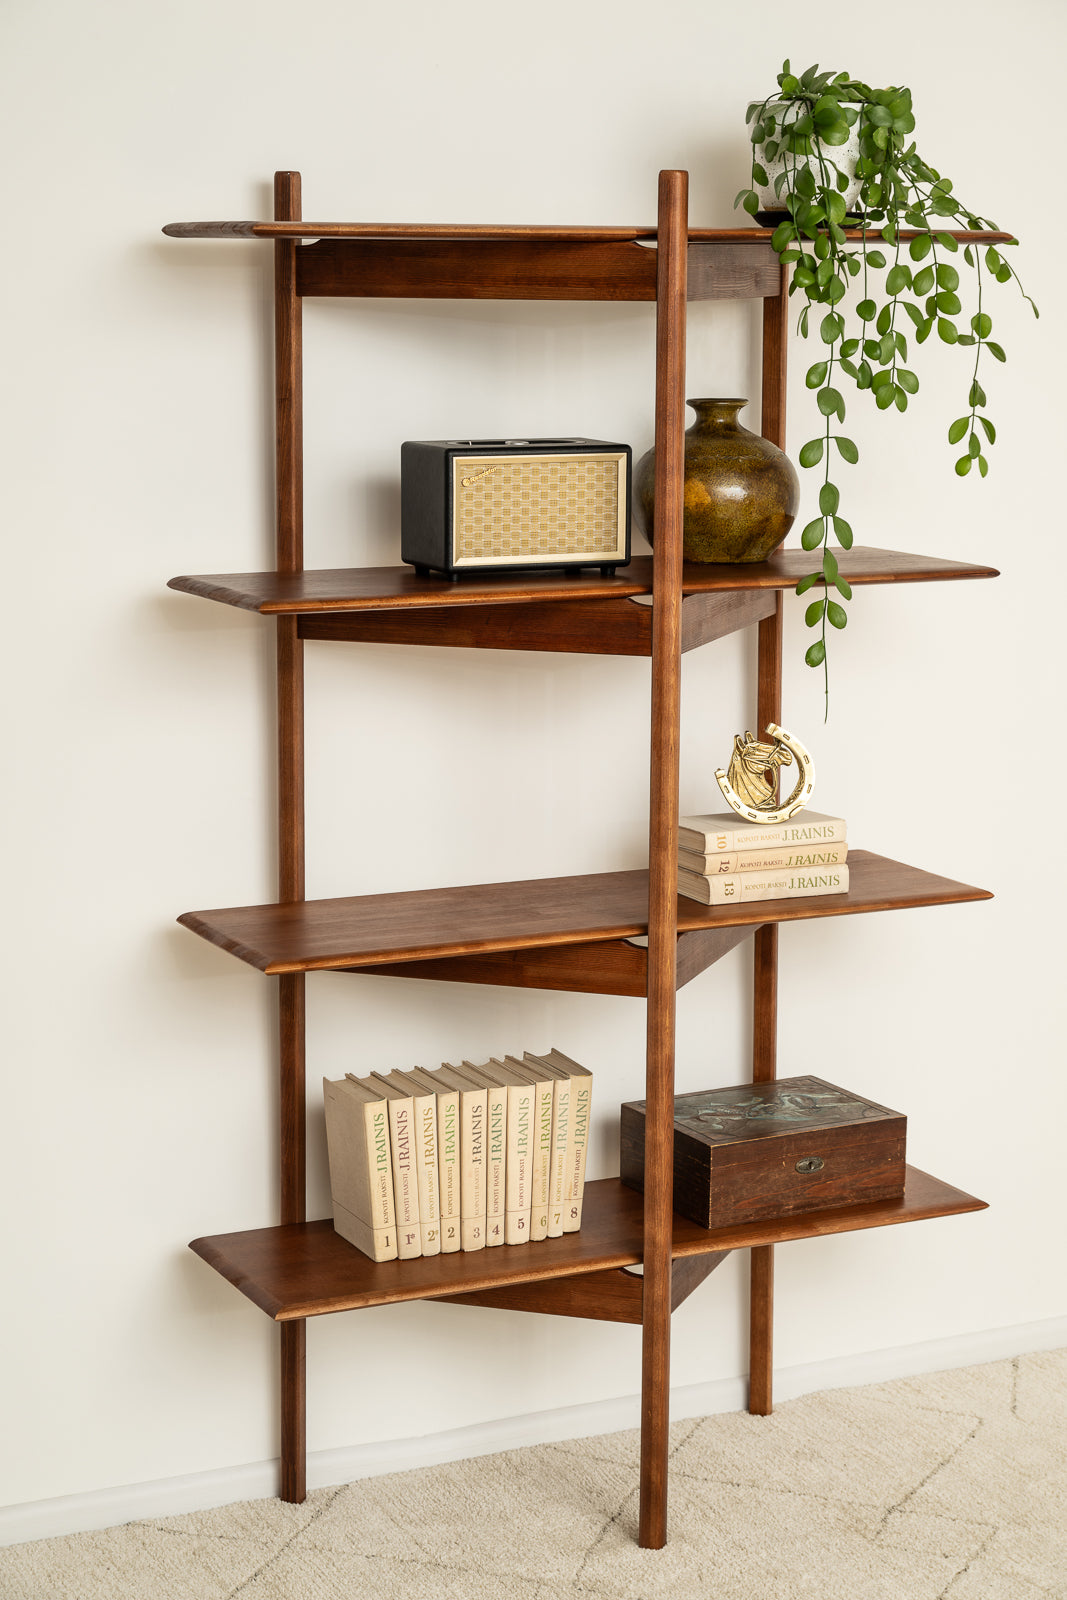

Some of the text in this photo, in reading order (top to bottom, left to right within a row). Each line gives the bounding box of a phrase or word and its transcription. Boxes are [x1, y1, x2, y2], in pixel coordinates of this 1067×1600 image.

[782, 826, 834, 841] J.RAINIS
[717, 835, 726, 849] 10
[719, 860, 730, 872] 12
[786, 853, 838, 866] J.RAINIS
[724, 882, 734, 896] 13
[789, 875, 840, 889] J.RAINIS
[541, 1093, 551, 1151] J.RAINIS
[557, 1093, 569, 1152] J.RAINIS
[574, 1090, 588, 1147] J.RAINIS
[491, 1104, 502, 1163] J.RAINIS
[518, 1097, 529, 1156] J.RAINIS
[397, 1111, 410, 1170] J.RAINIS
[424, 1107, 434, 1167] J.RAINIS
[445, 1104, 455, 1164] J.RAINIS
[472, 1105, 482, 1164] J.RAINIS
[374, 1113, 387, 1172] J.RAINIS
[554, 1213, 560, 1224] 7
[571, 1207, 577, 1218] 8
[518, 1218, 524, 1229] 5
[541, 1216, 546, 1227] 6
[448, 1227, 454, 1238] 2
[473, 1228, 480, 1238] 3
[492, 1225, 500, 1235] 4
[384, 1236, 391, 1247] 1
